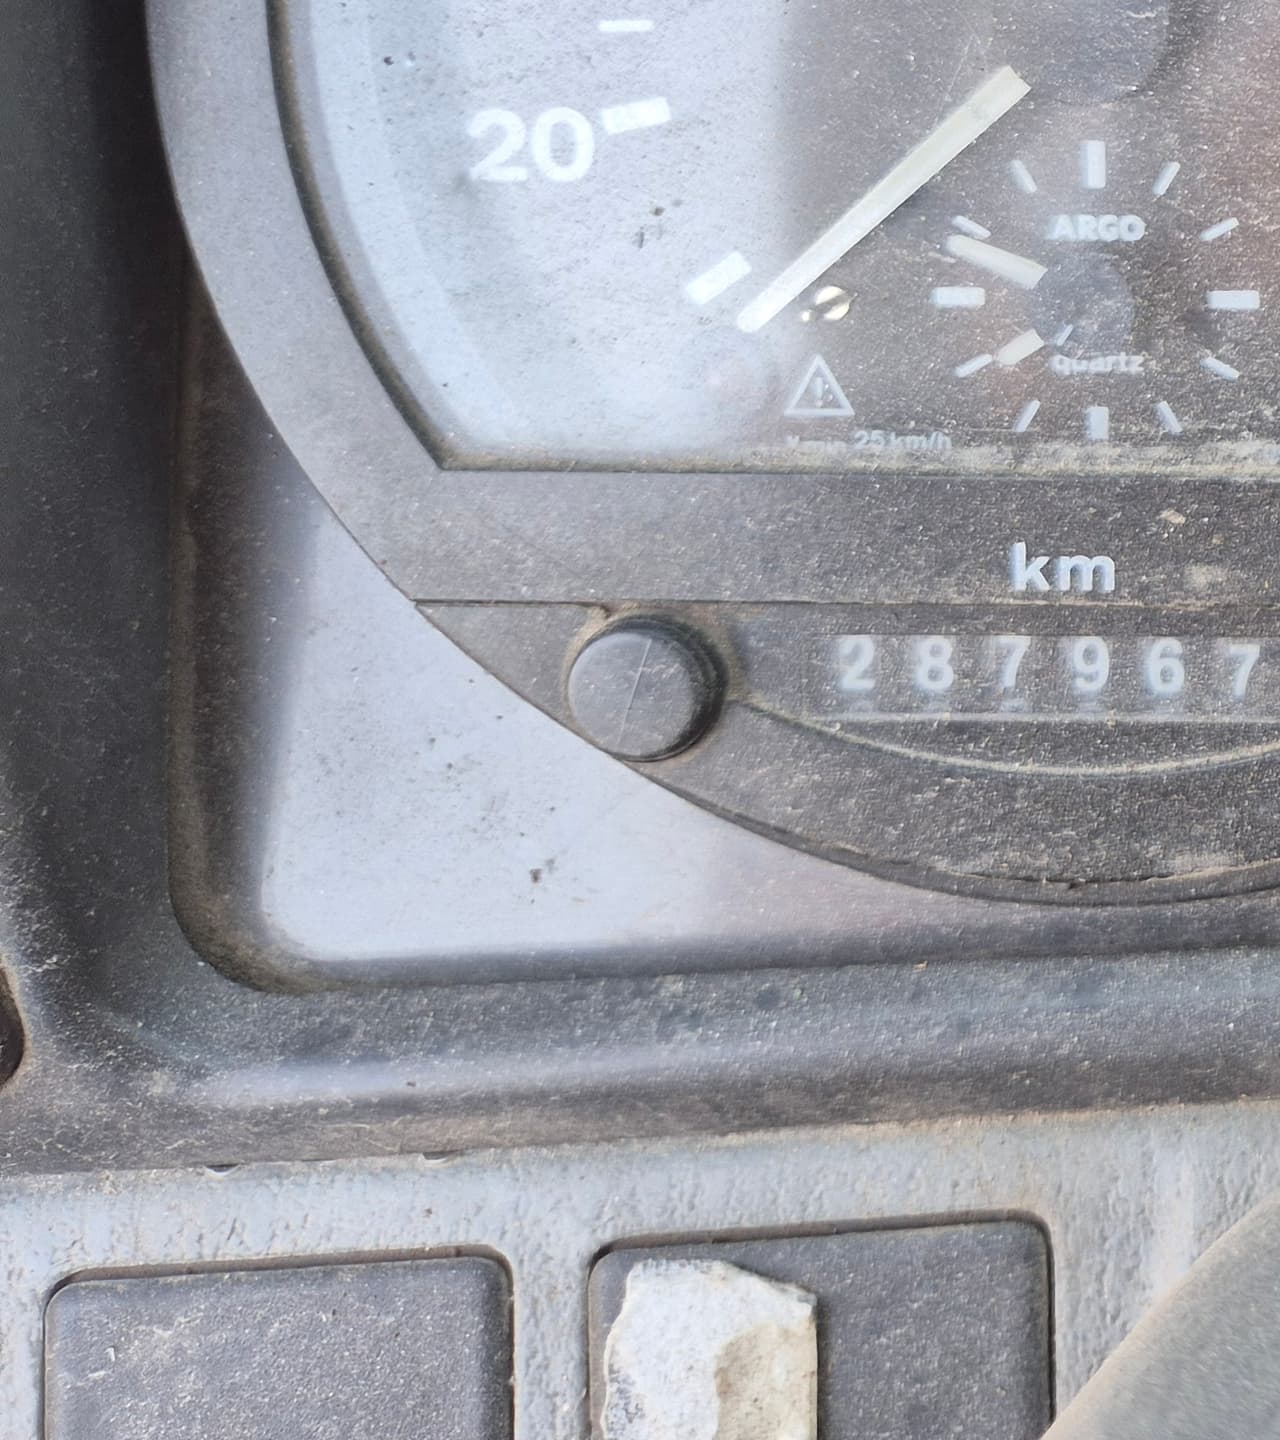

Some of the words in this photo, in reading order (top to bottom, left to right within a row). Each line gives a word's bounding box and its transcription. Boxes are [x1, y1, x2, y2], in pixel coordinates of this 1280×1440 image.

[465, 107, 595, 182] 20
[1048, 214, 1146, 242] ARGO
[1051, 352, 1144, 376] quartz
[1010, 543, 1116, 593] km
